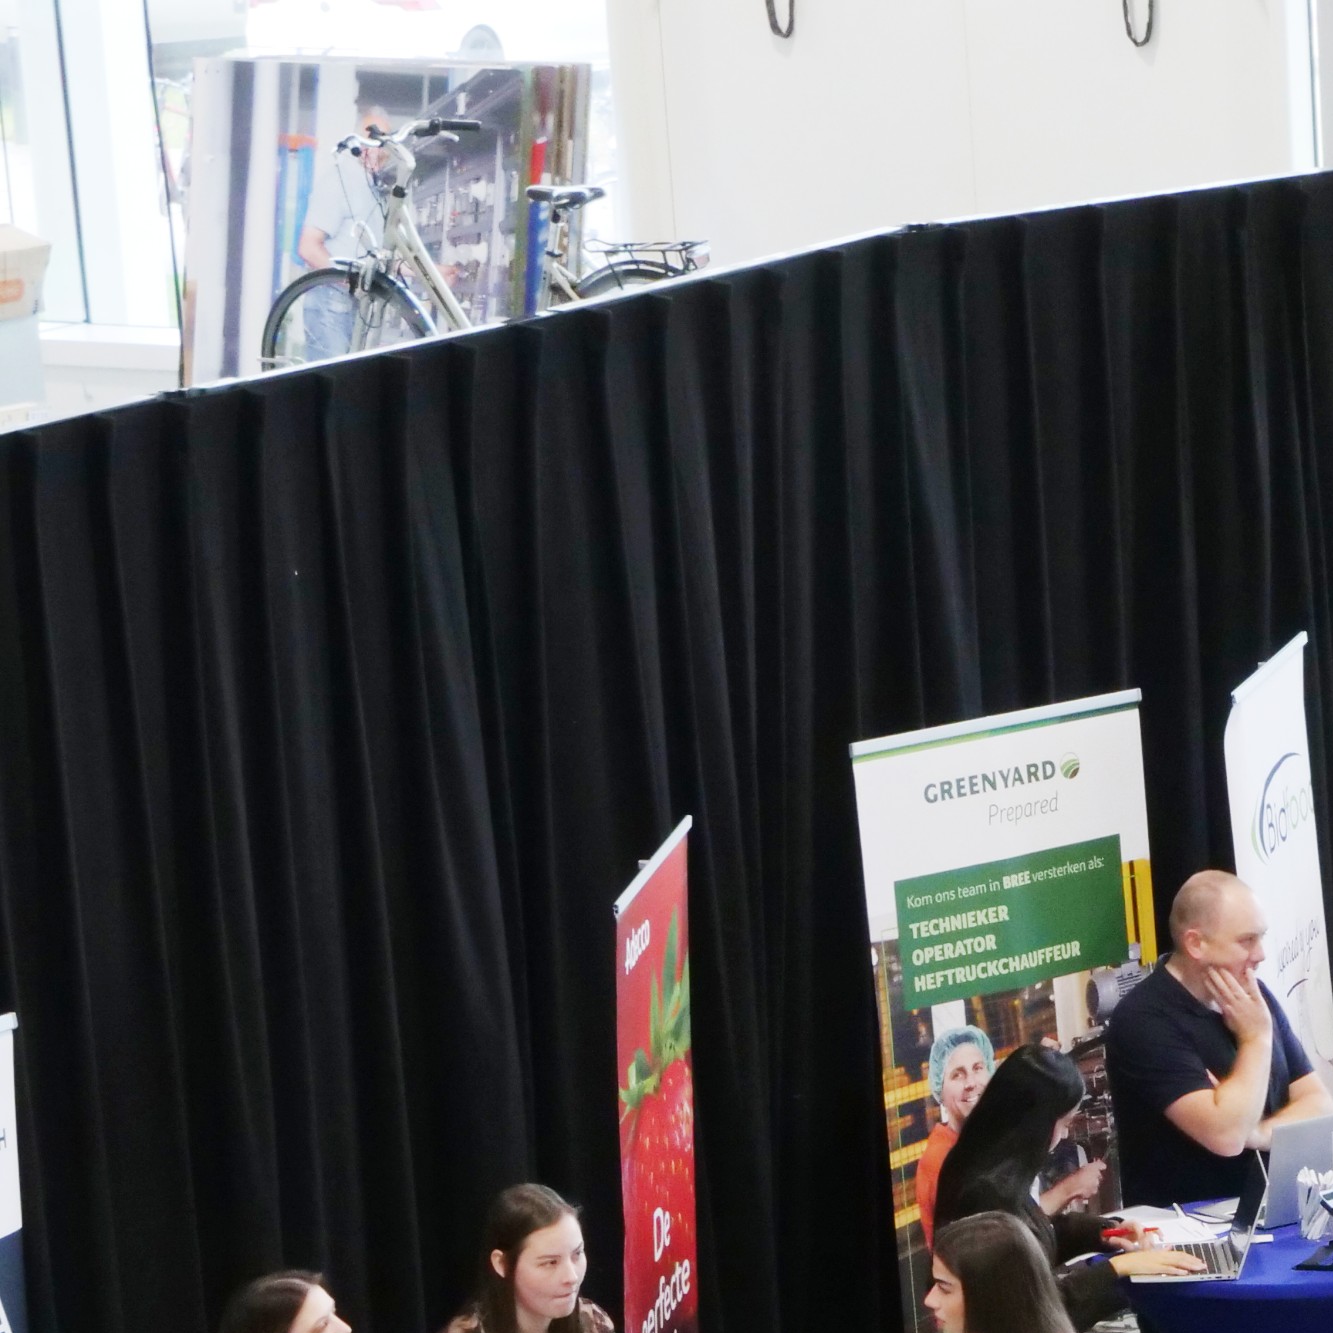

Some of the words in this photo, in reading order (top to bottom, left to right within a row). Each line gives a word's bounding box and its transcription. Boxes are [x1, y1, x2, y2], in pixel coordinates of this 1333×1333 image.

[924, 760, 1056, 804] GREENYARD
[988, 790, 1059, 826] Prepared
[906, 894, 933, 909] Kom
[935, 888, 956, 904] ons
[957, 883, 988, 899] team
[989, 879, 1001, 893] in
[1002, 871, 1031, 889] BREE
[1031, 860, 1086, 882] versterken
[1088, 856, 1105, 871] als:
[909, 905, 1010, 939] TECHNIEKER
[624, 919, 651, 975] Adecco
[912, 934, 997, 966] OPERATOR
[914, 941, 1081, 992] HEFTRUCKCHAUFFEUR
[653, 1206, 671, 1262] De
